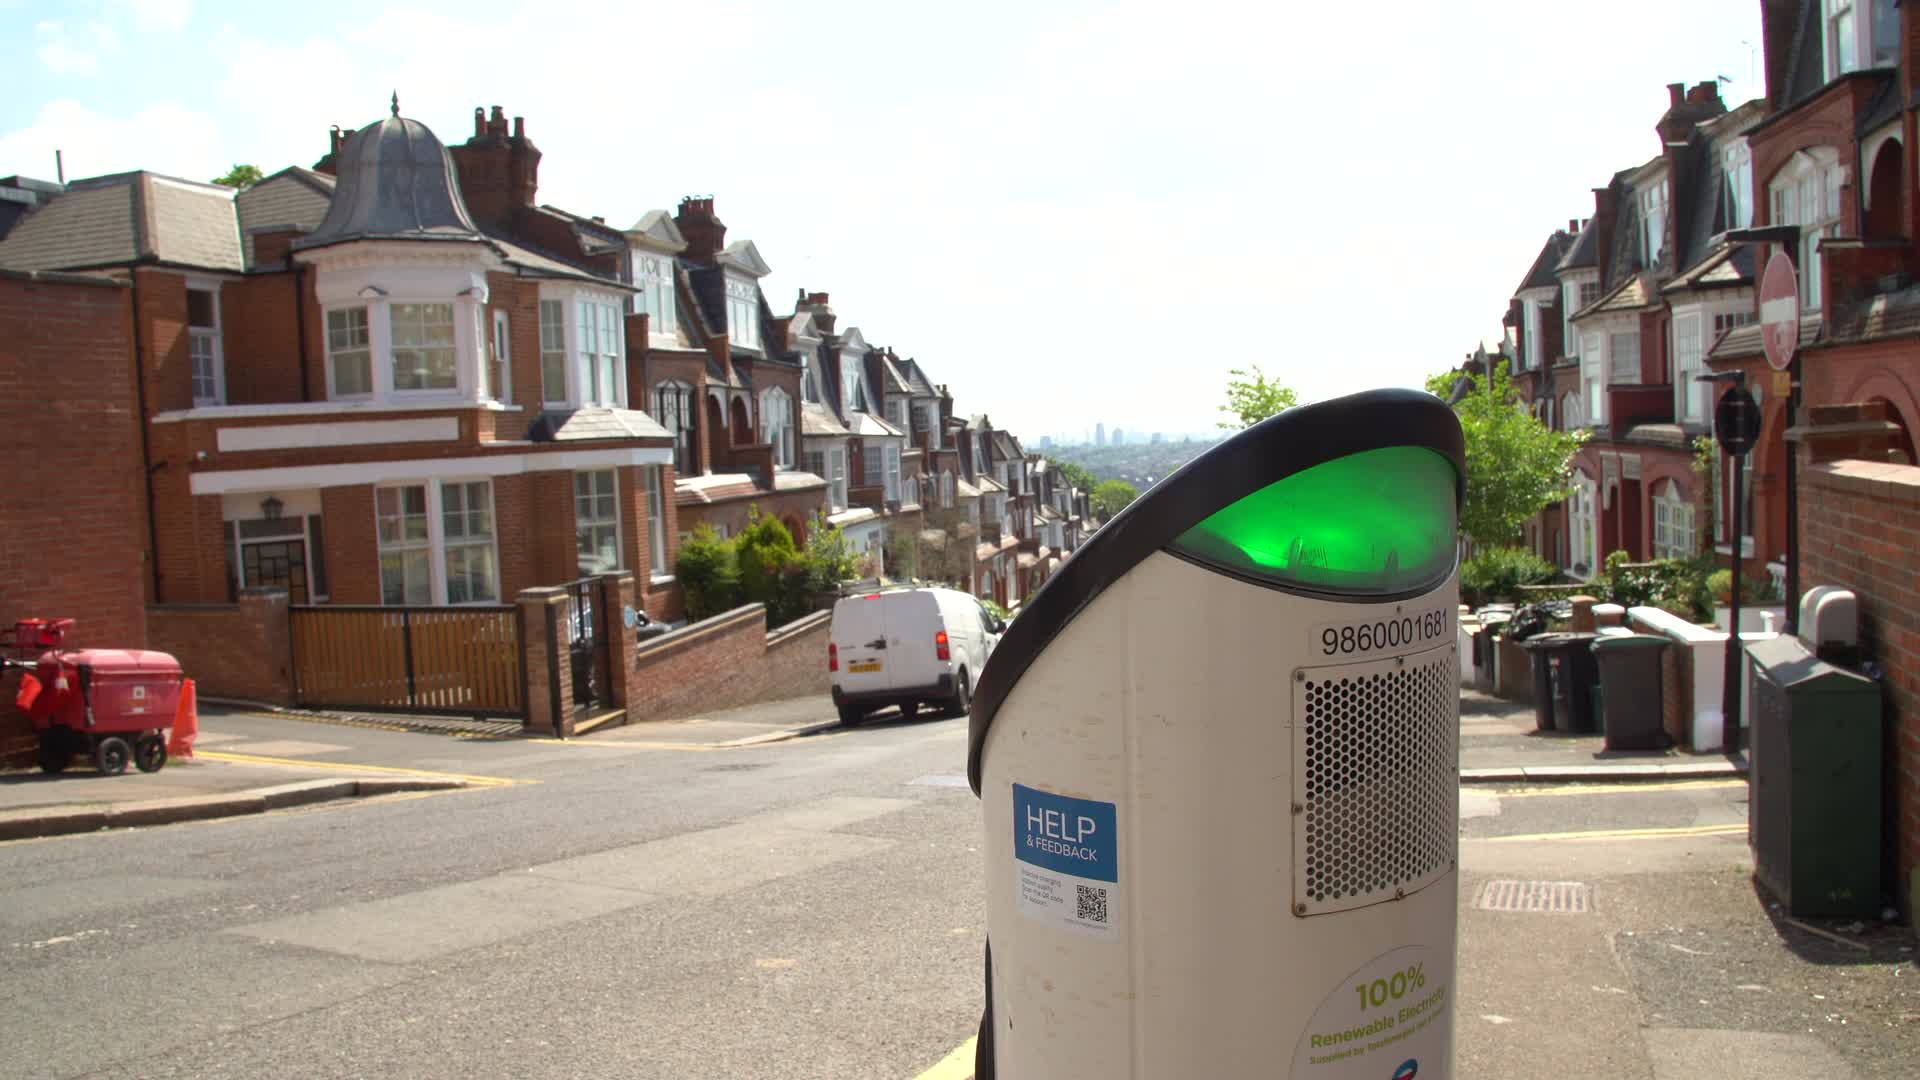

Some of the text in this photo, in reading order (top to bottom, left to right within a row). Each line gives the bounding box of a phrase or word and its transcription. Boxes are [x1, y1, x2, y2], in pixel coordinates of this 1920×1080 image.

[1322, 608, 1447, 655] 9860001681
[1026, 804, 1096, 844] HELP
[1026, 834, 1098, 862] & FEEDBACK
[1356, 960, 1425, 1012] 100%
[1310, 1015, 1395, 1048] Renewable
